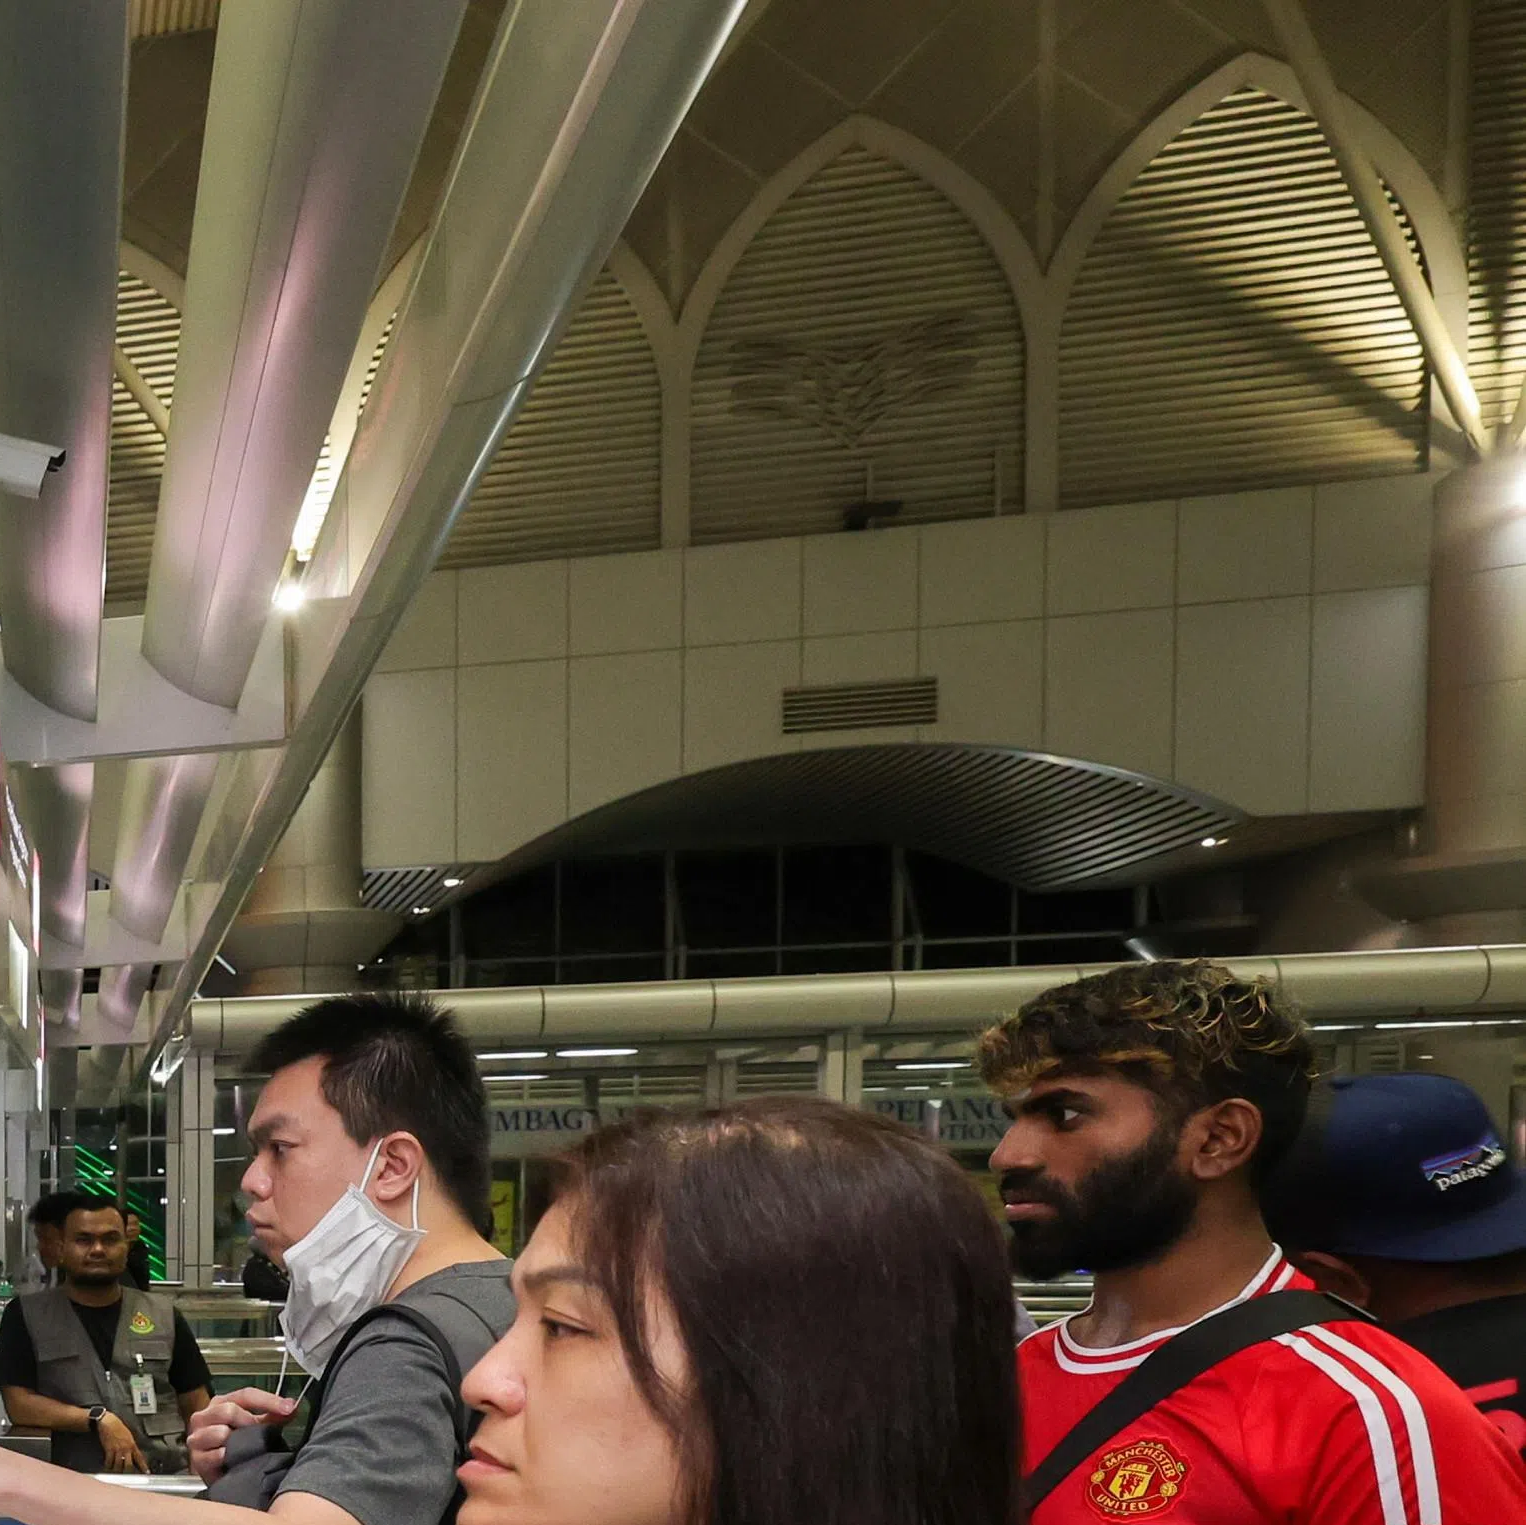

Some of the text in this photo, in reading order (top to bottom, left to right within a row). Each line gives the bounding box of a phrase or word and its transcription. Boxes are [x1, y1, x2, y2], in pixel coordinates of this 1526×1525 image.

[492, 1109, 597, 1132] MBAG
[1106, 1448, 1176, 1477] MANCHESTER
[1096, 1494, 1149, 1511] UNITED
